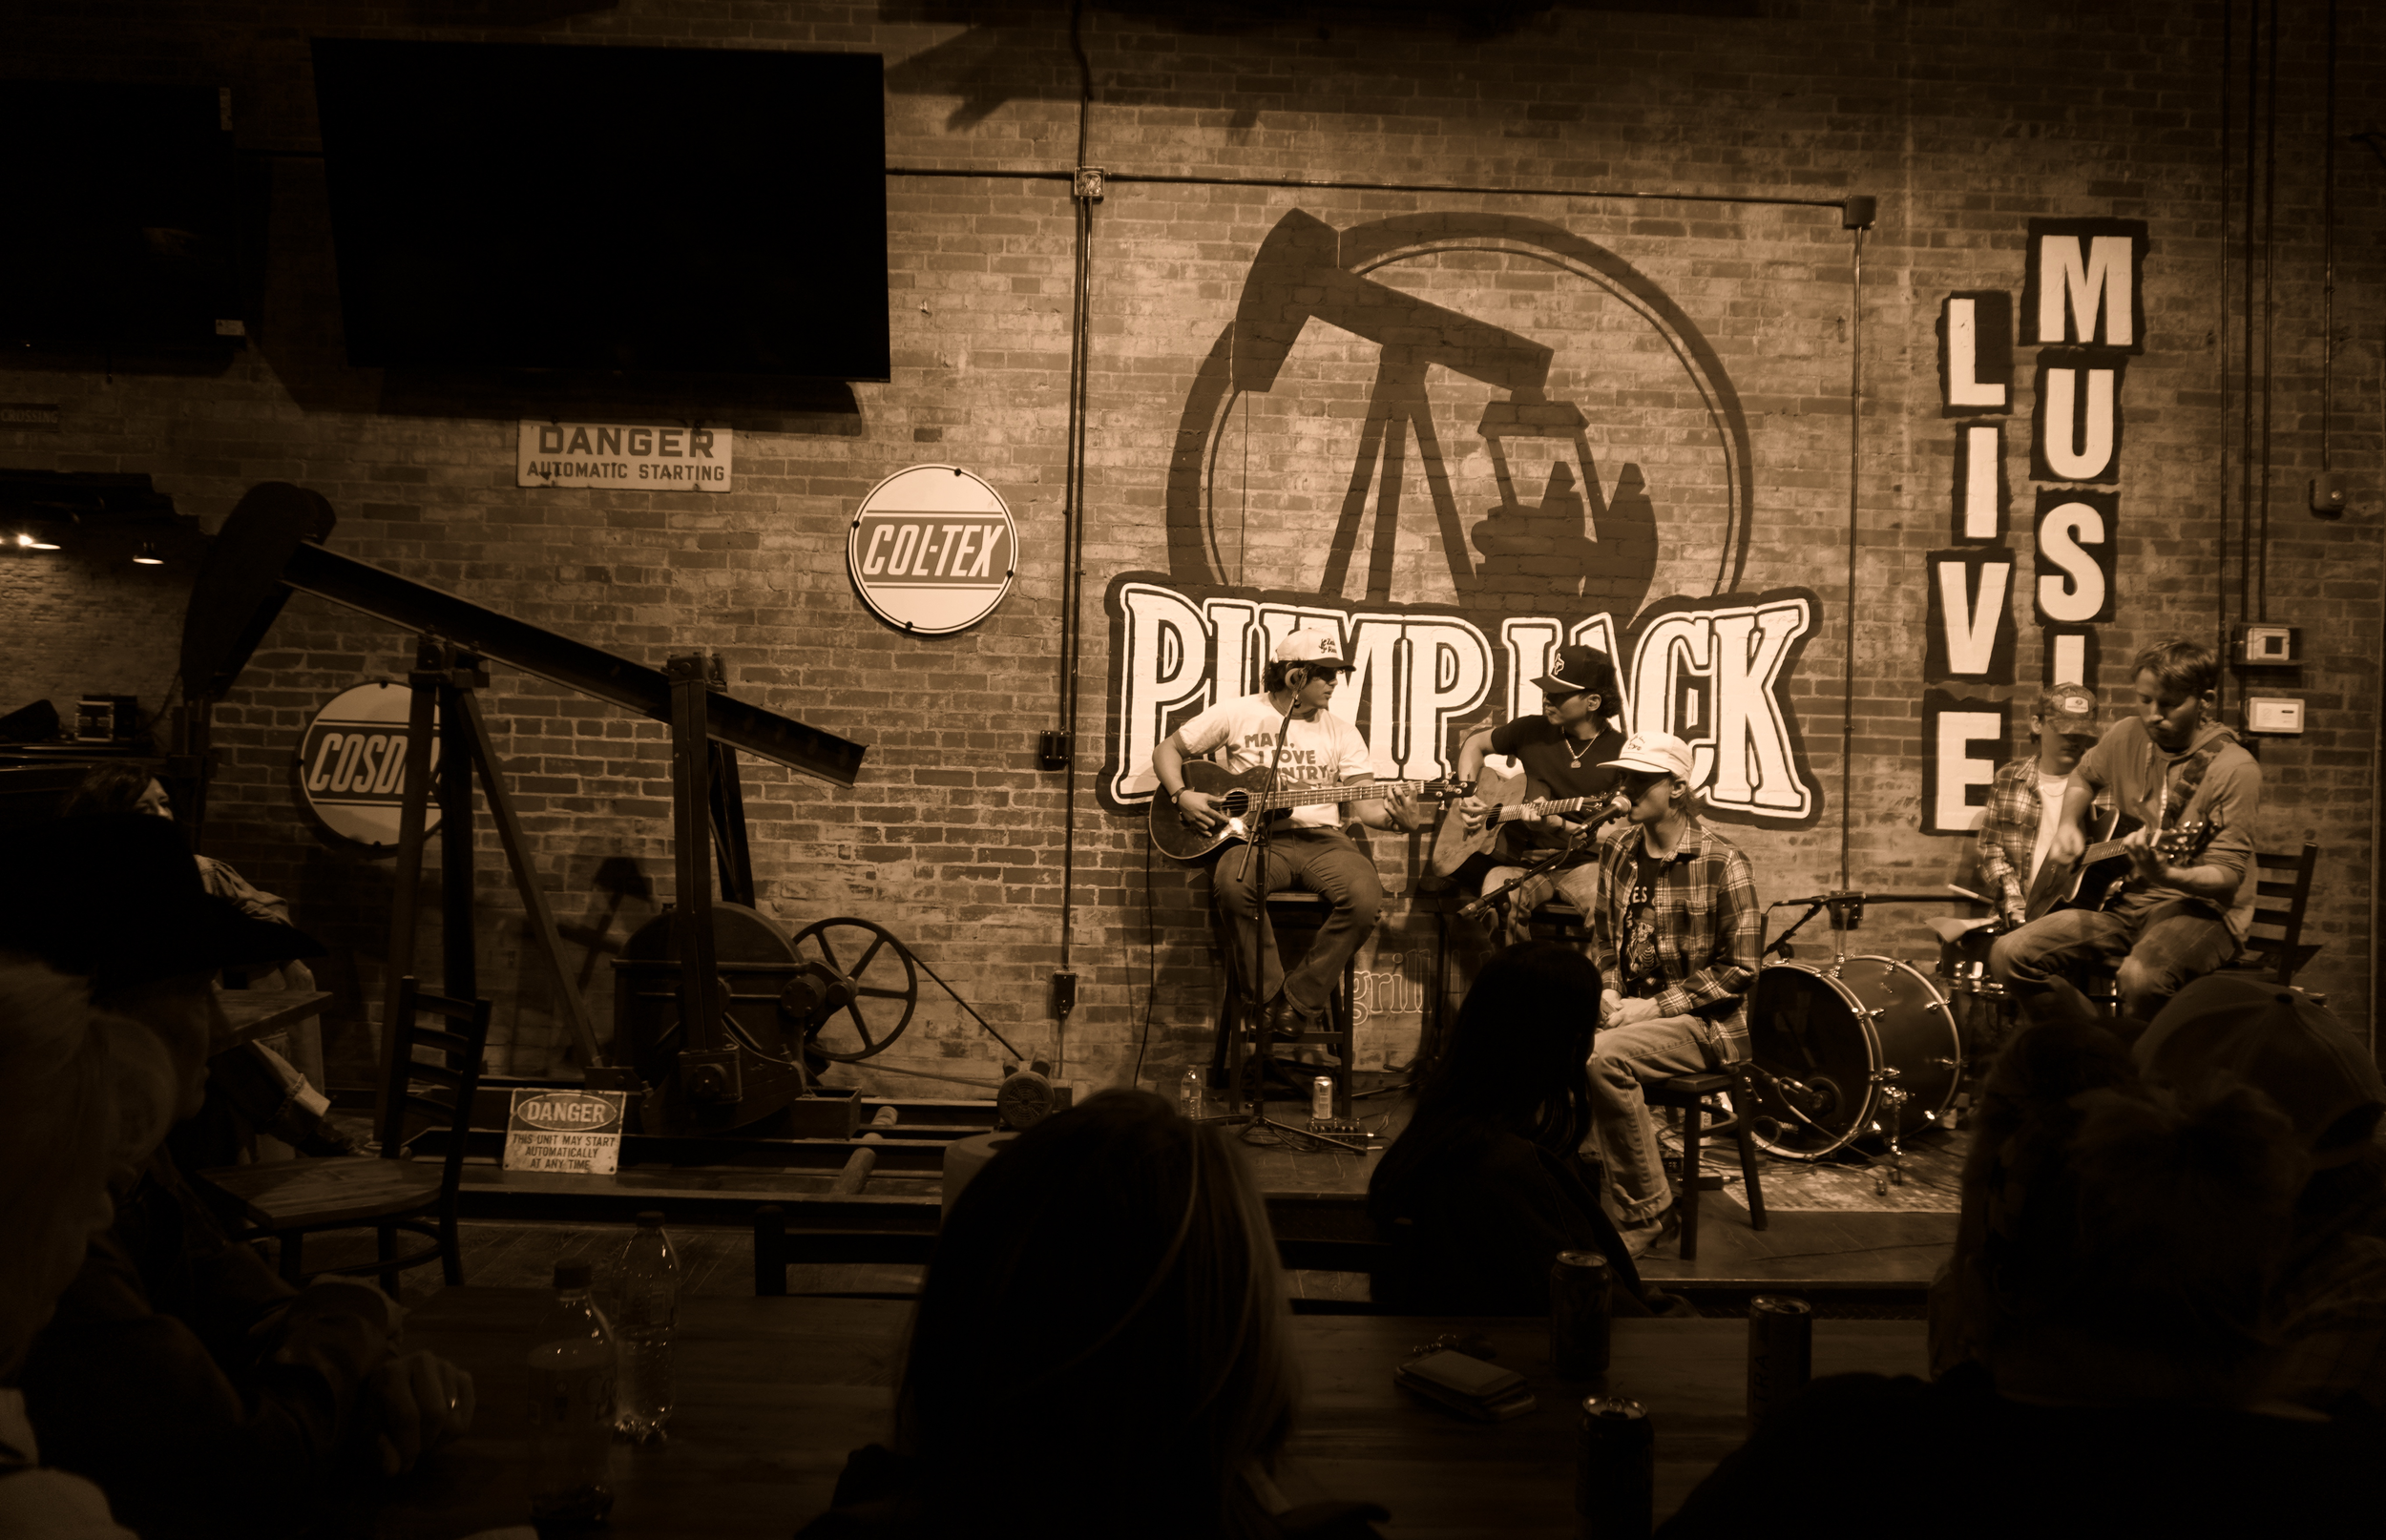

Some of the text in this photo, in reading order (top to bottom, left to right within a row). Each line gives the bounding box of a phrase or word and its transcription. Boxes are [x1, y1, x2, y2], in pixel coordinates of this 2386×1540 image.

[539, 426, 714, 458] DANGER
[527, 460, 724, 481] AUTOMATIC STARTING
[863, 524, 1005, 577] COL-TEX
[1936, 298, 2011, 831] LIVE
[307, 732, 441, 795] COSD
[1278, 765, 1328, 780] NTRY
[527, 1102, 606, 1122] DANGER
[513, 1134, 616, 1147] THIS UNIT MAY START
[525, 1147, 598, 1158] AUTOMATICALLY
[530, 1158, 590, 1170] AT ANY TIME
